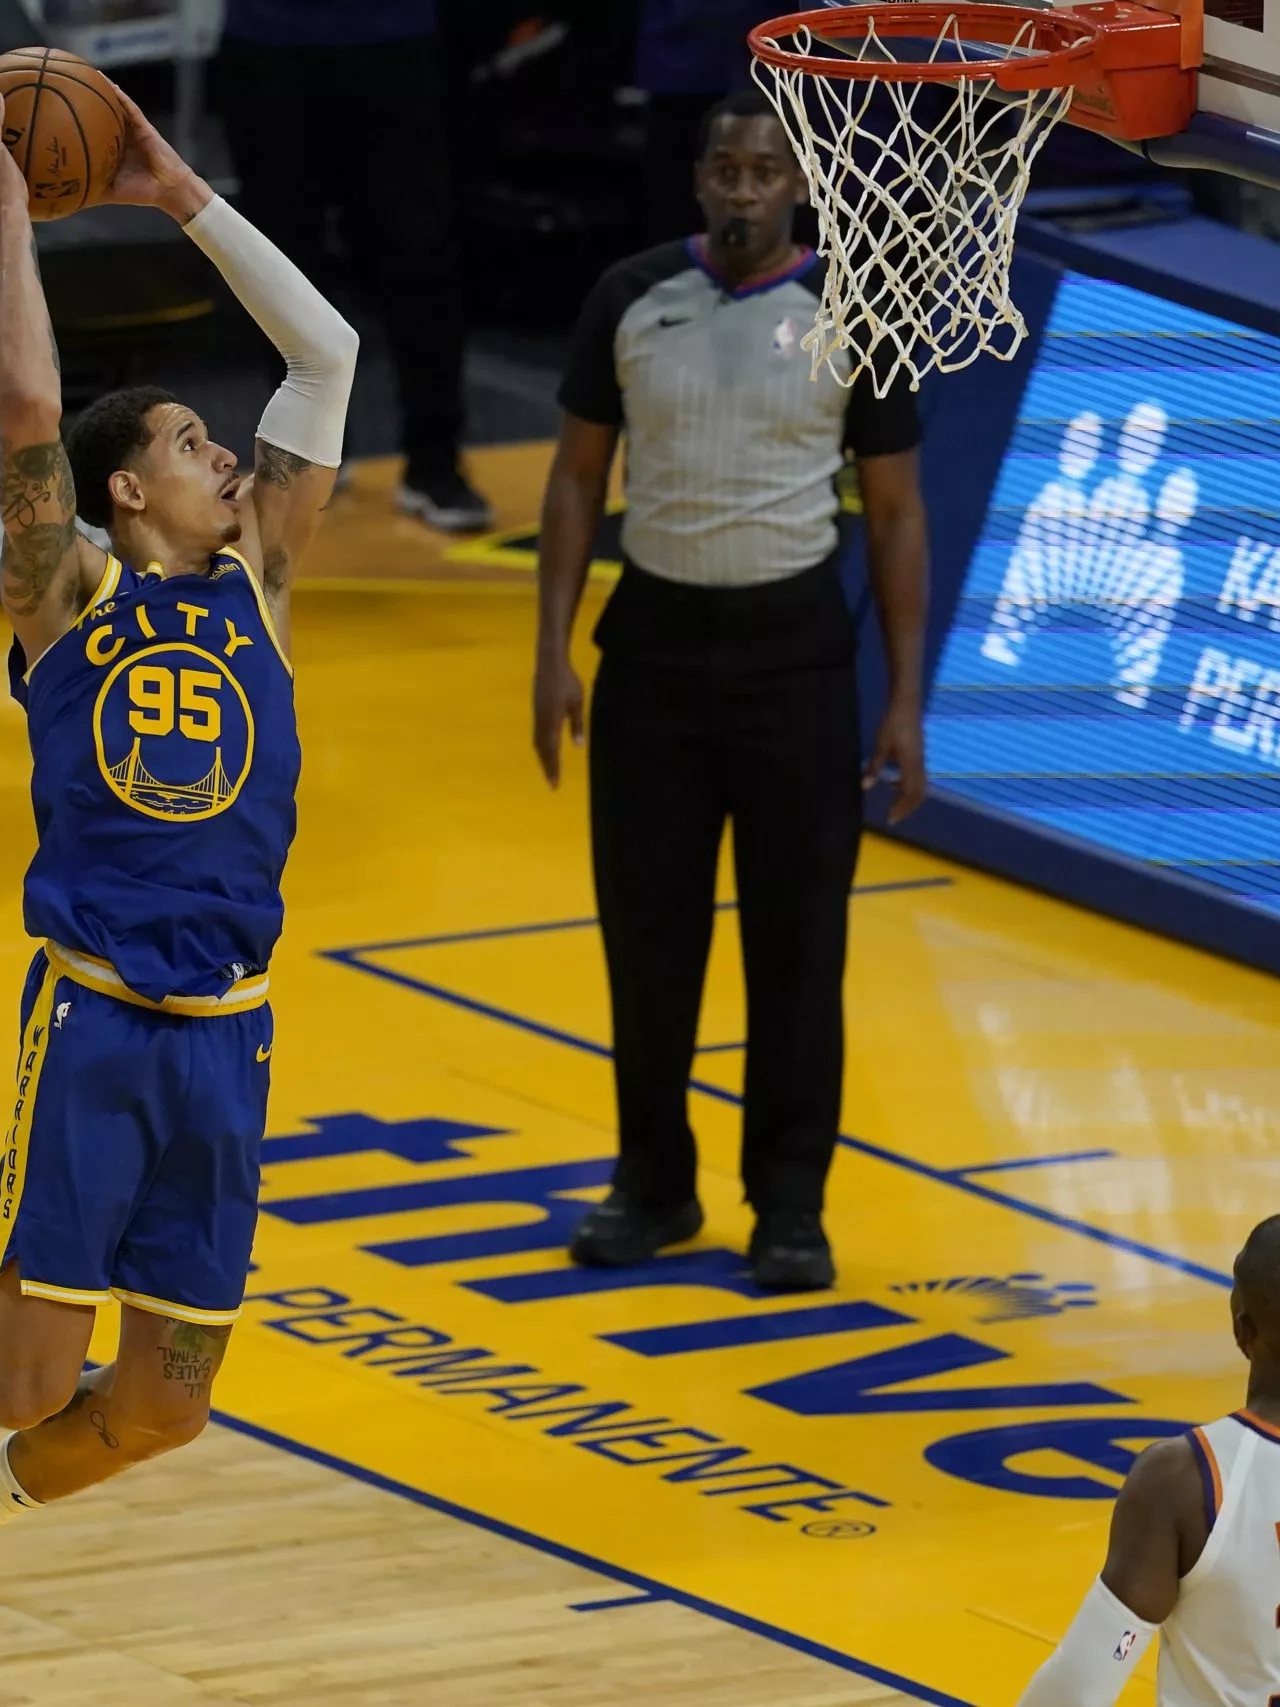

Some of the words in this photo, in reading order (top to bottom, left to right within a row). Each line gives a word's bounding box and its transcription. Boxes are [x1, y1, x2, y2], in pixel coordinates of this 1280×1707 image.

[86, 602, 254, 666] CITY
[129, 665, 222, 743] 95
[3, 1024, 45, 1220] WARRIORS
[257, 1112, 1202, 1500] thrive
[156, 1345, 201, 1364] FINAL
[162, 1356, 213, 1380] SALES
